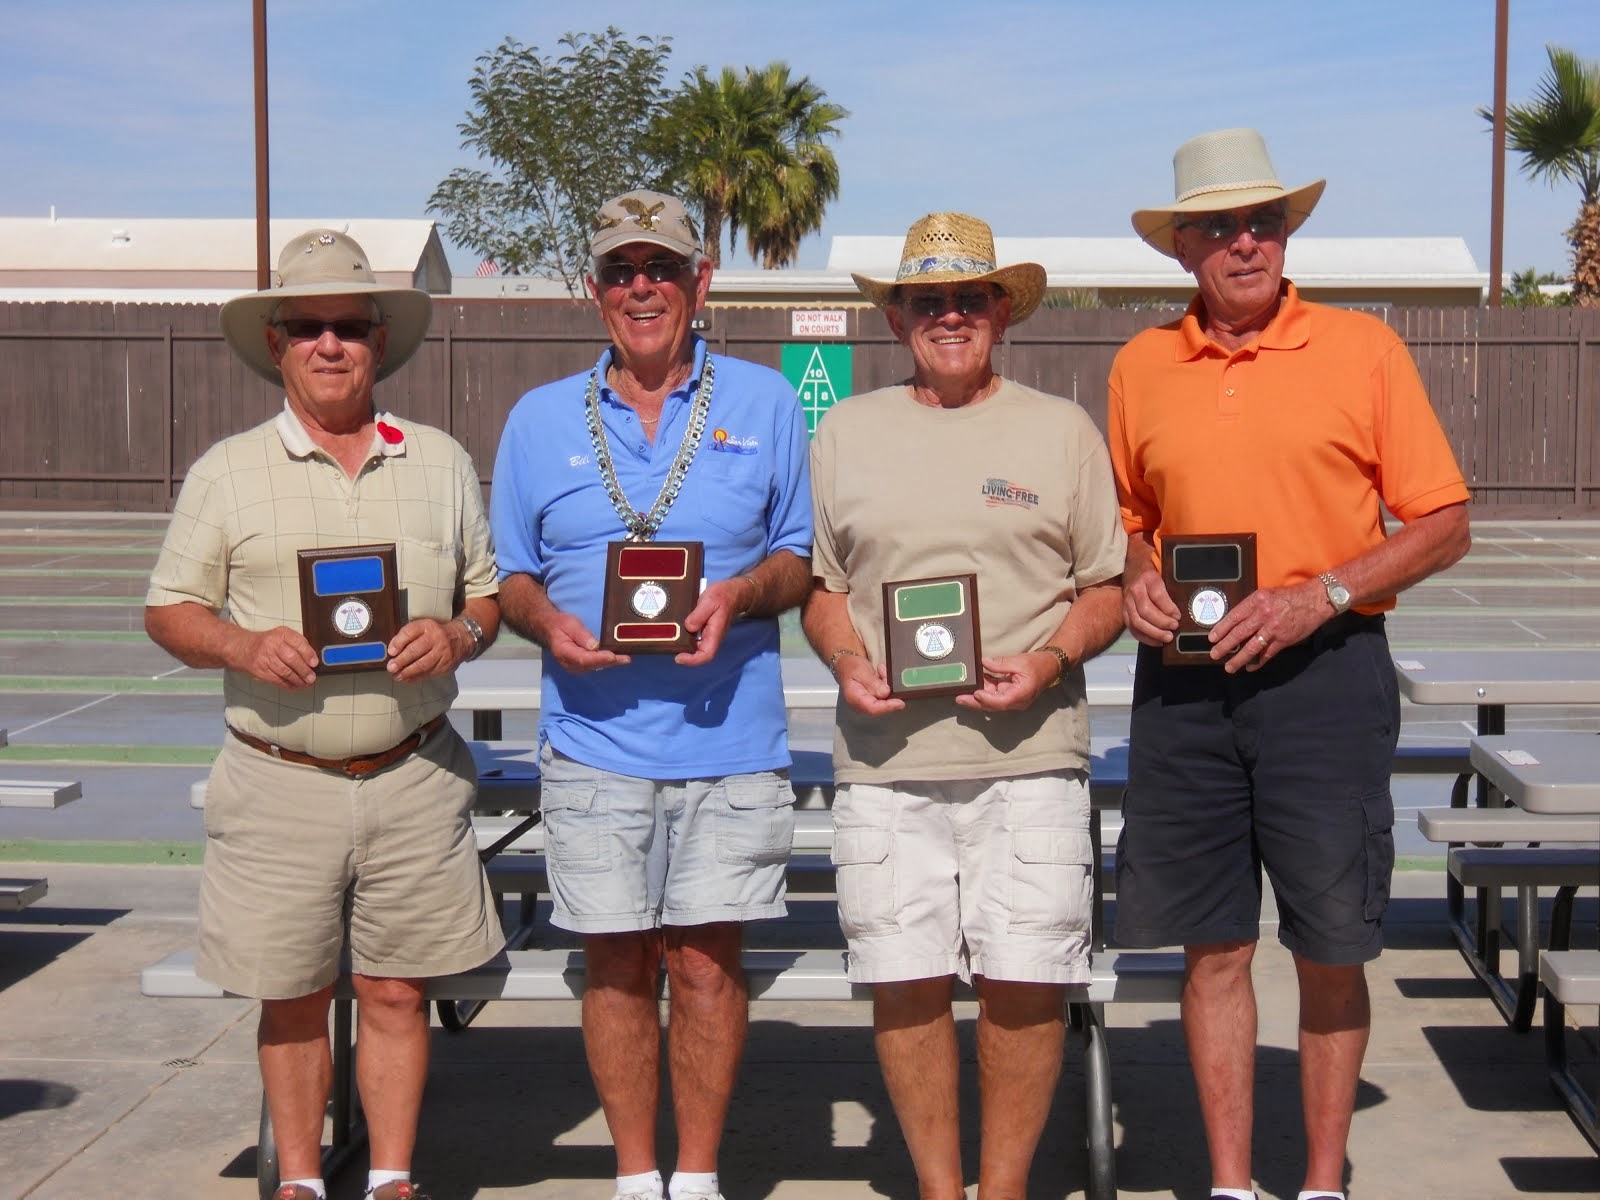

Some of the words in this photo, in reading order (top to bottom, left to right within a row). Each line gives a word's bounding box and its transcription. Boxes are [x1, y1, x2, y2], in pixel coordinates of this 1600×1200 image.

[796, 314, 805, 322] DO
[807, 314, 821, 322] NOT
[823, 314, 843, 322] WALK
[799, 325, 809, 333] ON
[811, 325, 840, 333] COURTS
[810, 369, 823, 378] 10
[804, 391, 811, 400] 8
[821, 391, 829, 400] 8
